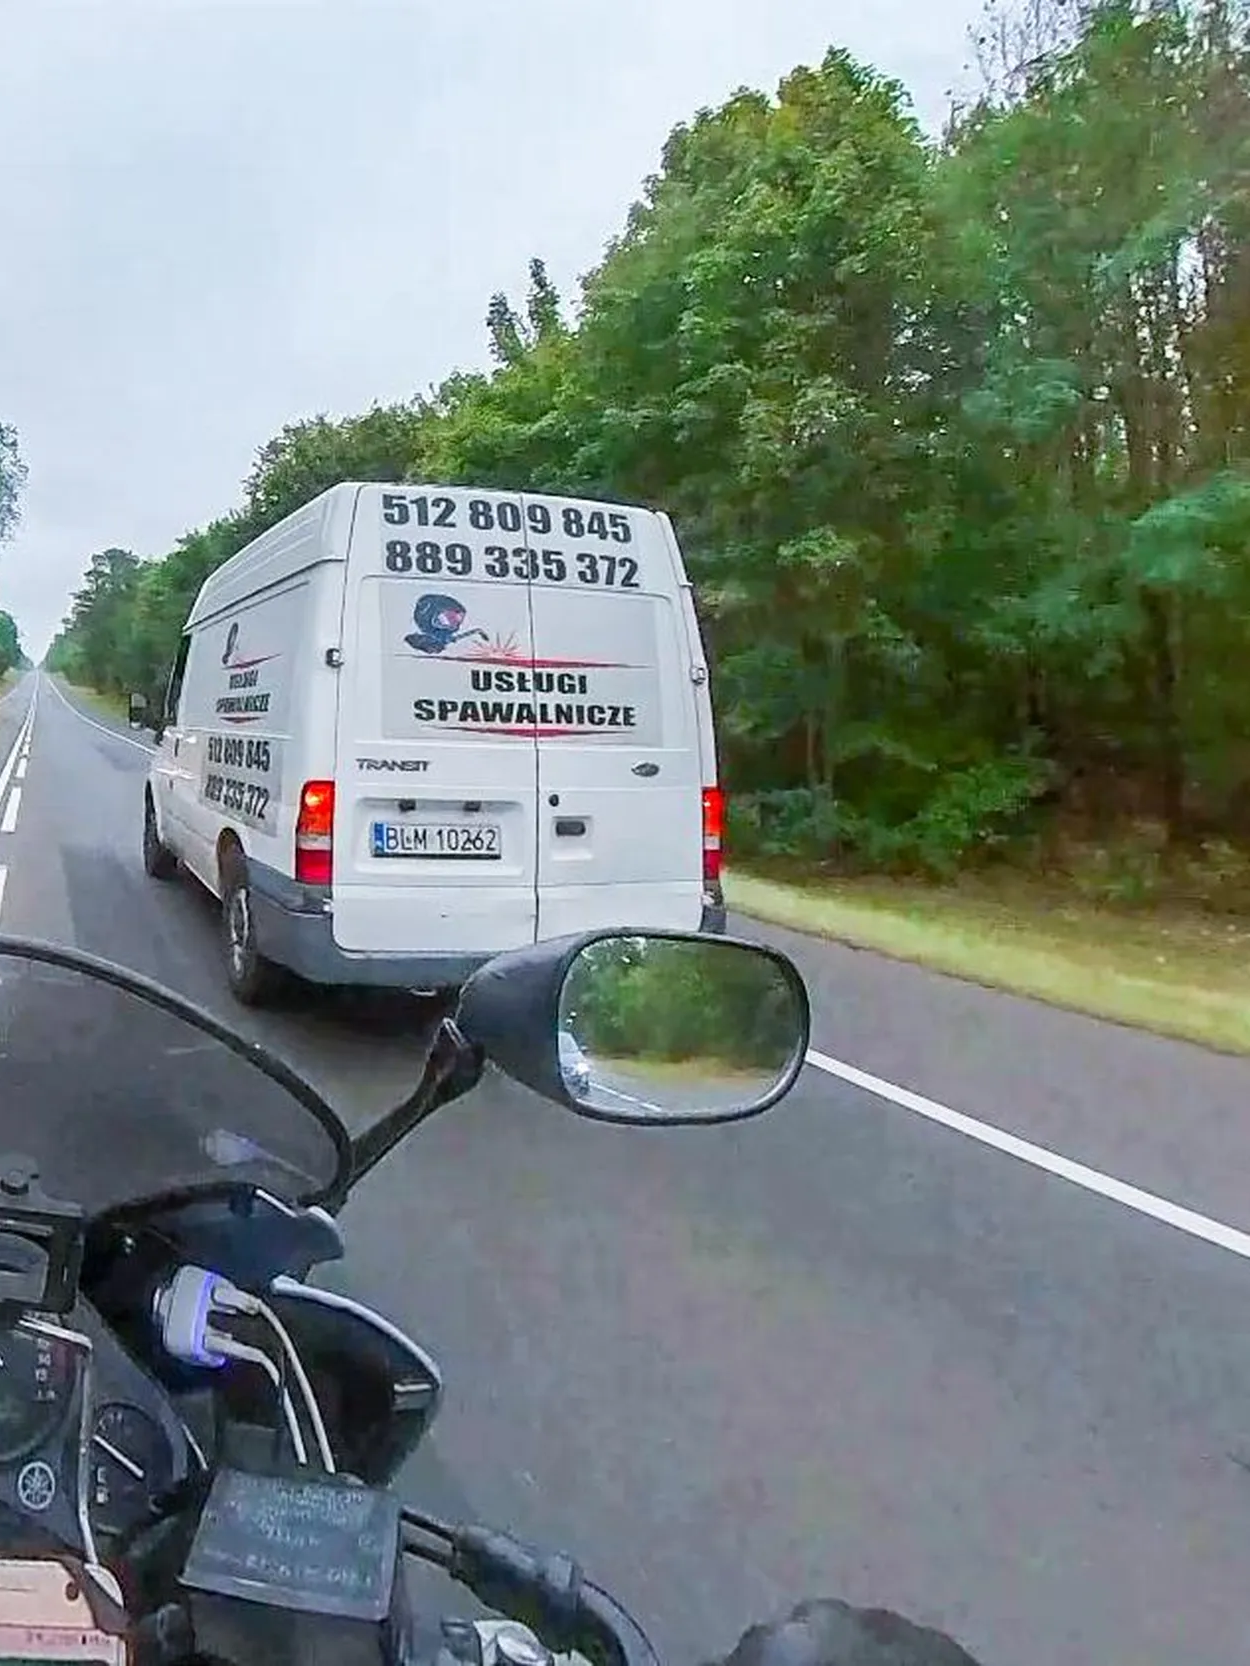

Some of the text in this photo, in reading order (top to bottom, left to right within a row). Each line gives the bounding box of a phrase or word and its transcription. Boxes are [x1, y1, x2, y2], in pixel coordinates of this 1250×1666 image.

[382, 494, 632, 543] 512 809 845
[386, 540, 640, 588] 889 335 372
[471, 670, 587, 694] USŁUGI
[414, 699, 636, 726] SPAWALNICZE
[208, 737, 223, 764] 512
[246, 740, 270, 772] 845
[356, 758, 430, 772] TRANSIT
[247, 783, 270, 820] 372
[386, 827, 496, 851] BLM 10262
